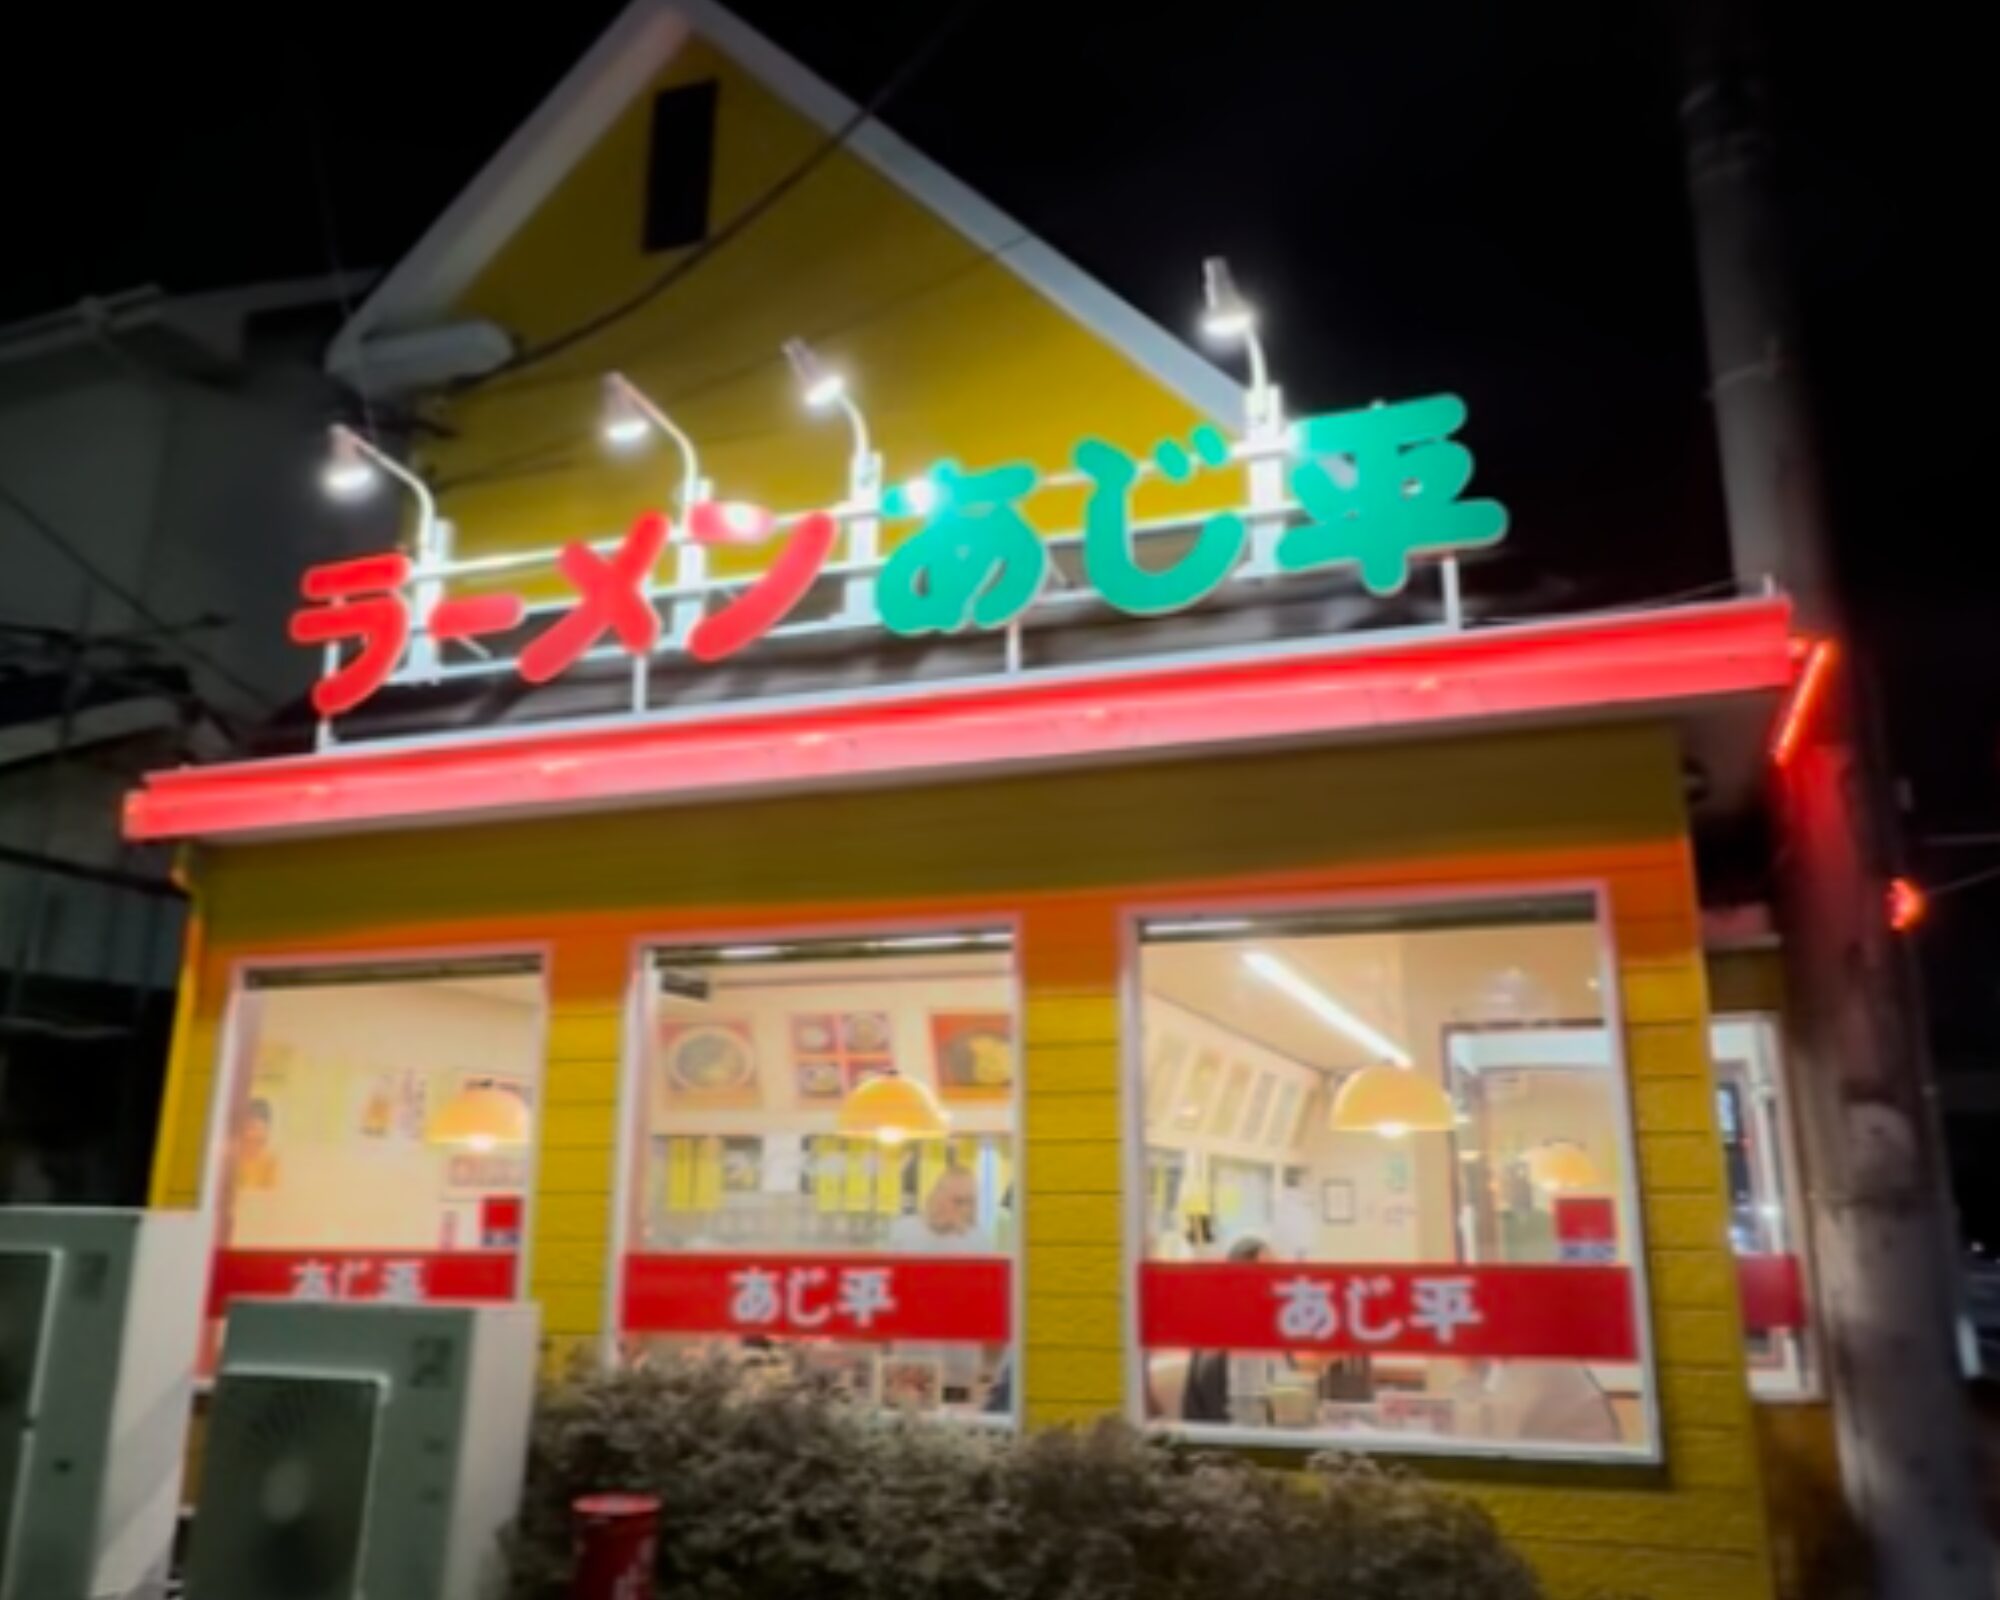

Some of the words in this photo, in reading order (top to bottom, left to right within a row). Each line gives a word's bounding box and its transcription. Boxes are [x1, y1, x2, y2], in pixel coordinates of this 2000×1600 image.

[729, 1266, 898, 1328] あじ平
[1271, 1275, 1484, 1344] あじ平
